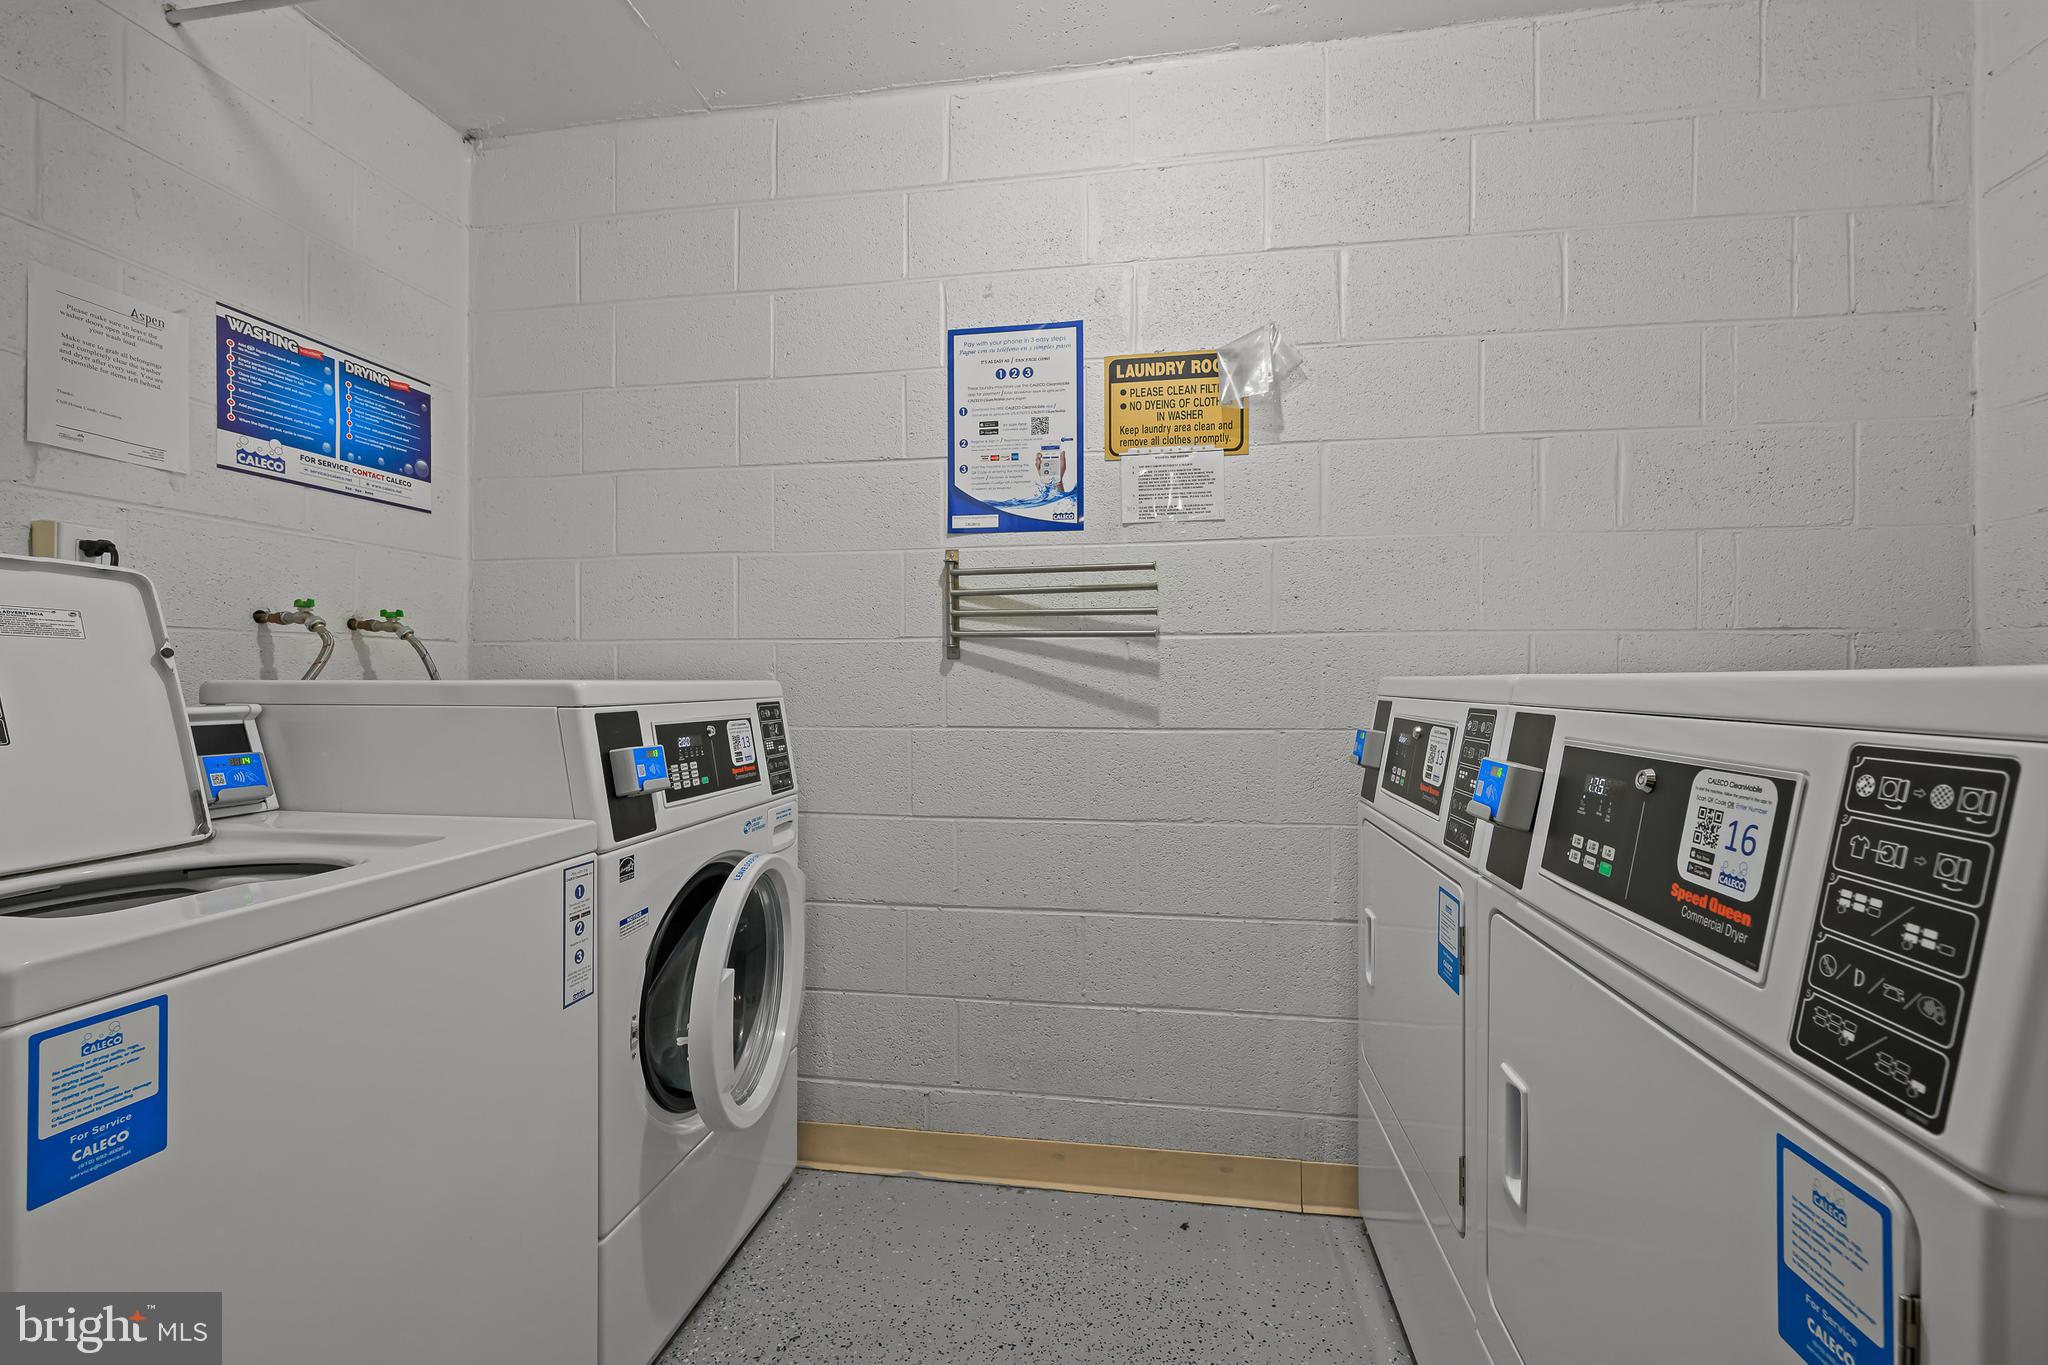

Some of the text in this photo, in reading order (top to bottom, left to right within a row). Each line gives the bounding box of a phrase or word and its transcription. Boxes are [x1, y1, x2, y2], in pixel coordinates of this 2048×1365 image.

[66, 303, 87, 315] Please
[131, 308, 165, 328] Aspen
[226, 315, 299, 354] WASHING
[1003, 338, 1022, 346] phone
[1050, 334, 1066, 342] steps
[344, 360, 390, 387] DRYING
[1116, 358, 1218, 378] LAUNDRY ROO
[1130, 387, 1163, 398] PLEASE
[1167, 386, 1196, 396] CLEAN
[1130, 401, 1142, 411] NO
[1145, 400, 1176, 410] DYEING
[1180, 398, 1190, 408] OF
[1157, 410, 1203, 421] IN WASHER
[1120, 426, 1139, 436] Keep
[1142, 424, 1171, 434] laundry
[1194, 422, 1215, 431] clean
[1218, 421, 1232, 430] and
[1120, 433, 1231, 447] remove all clothes promptly.
[238, 452, 284, 472] CALECO
[300, 455, 412, 488] FOR SERVICE, CONTACT CALECO
[742, 736, 750, 748] 13
[1436, 749, 1445, 766] 15
[1856, 756, 1860, 764] 1
[1708, 777, 1762, 794] CALECO CleanMobile
[1696, 794, 1708, 802] Scan
[1714, 798, 1727, 806] Code
[1728, 800, 1734, 808] OR
[1842, 815, 1848, 824] 2
[1724, 820, 1759, 856] 16
[1718, 874, 1746, 890] CALECO
[1829, 873, 1835, 882] 3
[1670, 883, 1752, 927] Speed Queen
[1681, 905, 1748, 944] Commercial Dryer
[1817, 930, 1824, 940] 4
[1805, 989, 1812, 999] 5
[82, 1036, 122, 1055] CALECO
[70, 1113, 132, 1144] For Service
[72, 1130, 130, 1162] CALECO
[1814, 1192, 1847, 1226] CALECO
[1805, 1294, 1858, 1348] For Service
[1807, 1317, 1855, 1365] CALECO
